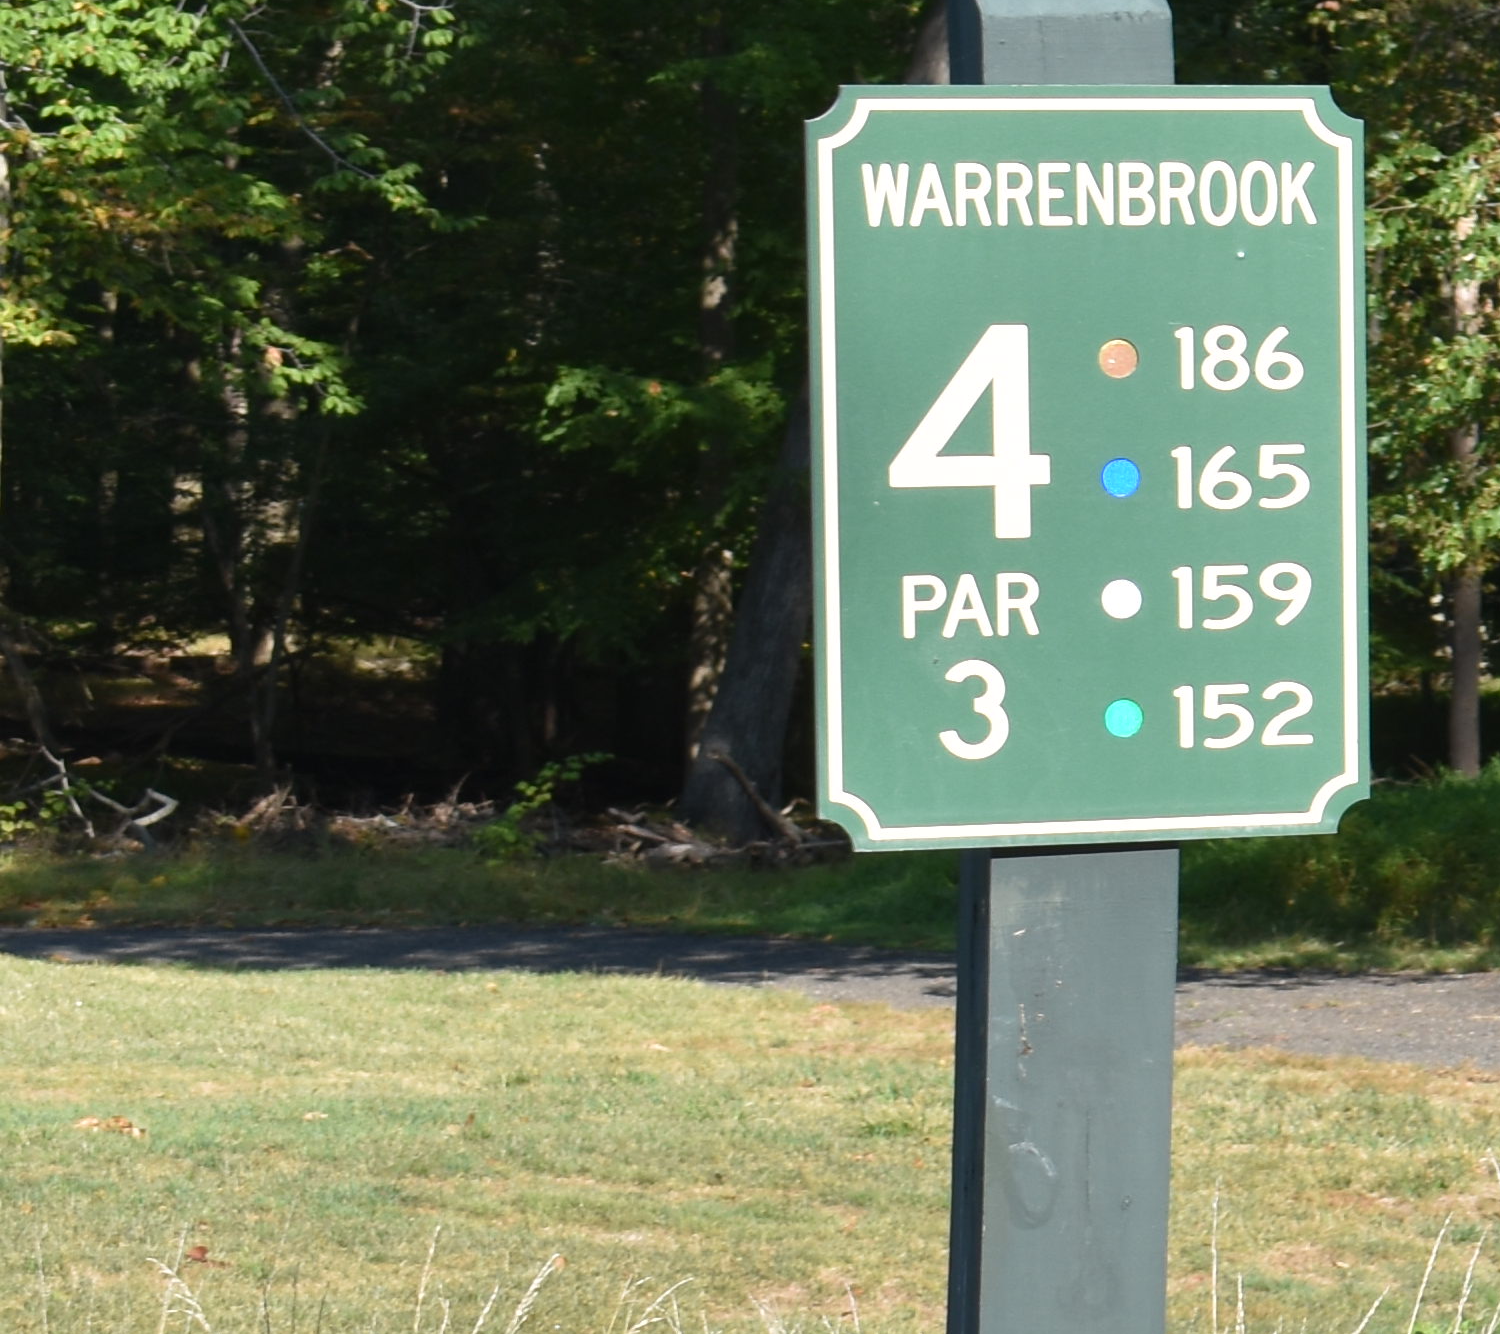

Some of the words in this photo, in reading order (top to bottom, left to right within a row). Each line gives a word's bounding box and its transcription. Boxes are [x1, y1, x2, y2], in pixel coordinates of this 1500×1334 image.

[860, 160, 1319, 228] WARRENBROOK
[1173, 324, 1305, 391] 186
[888, 324, 1051, 539] 4
[1170, 444, 1312, 510] 165
[902, 573, 1040, 639] PAR
[1171, 562, 1313, 630] 159
[938, 659, 1010, 760] 3
[1172, 681, 1315, 749] 152
